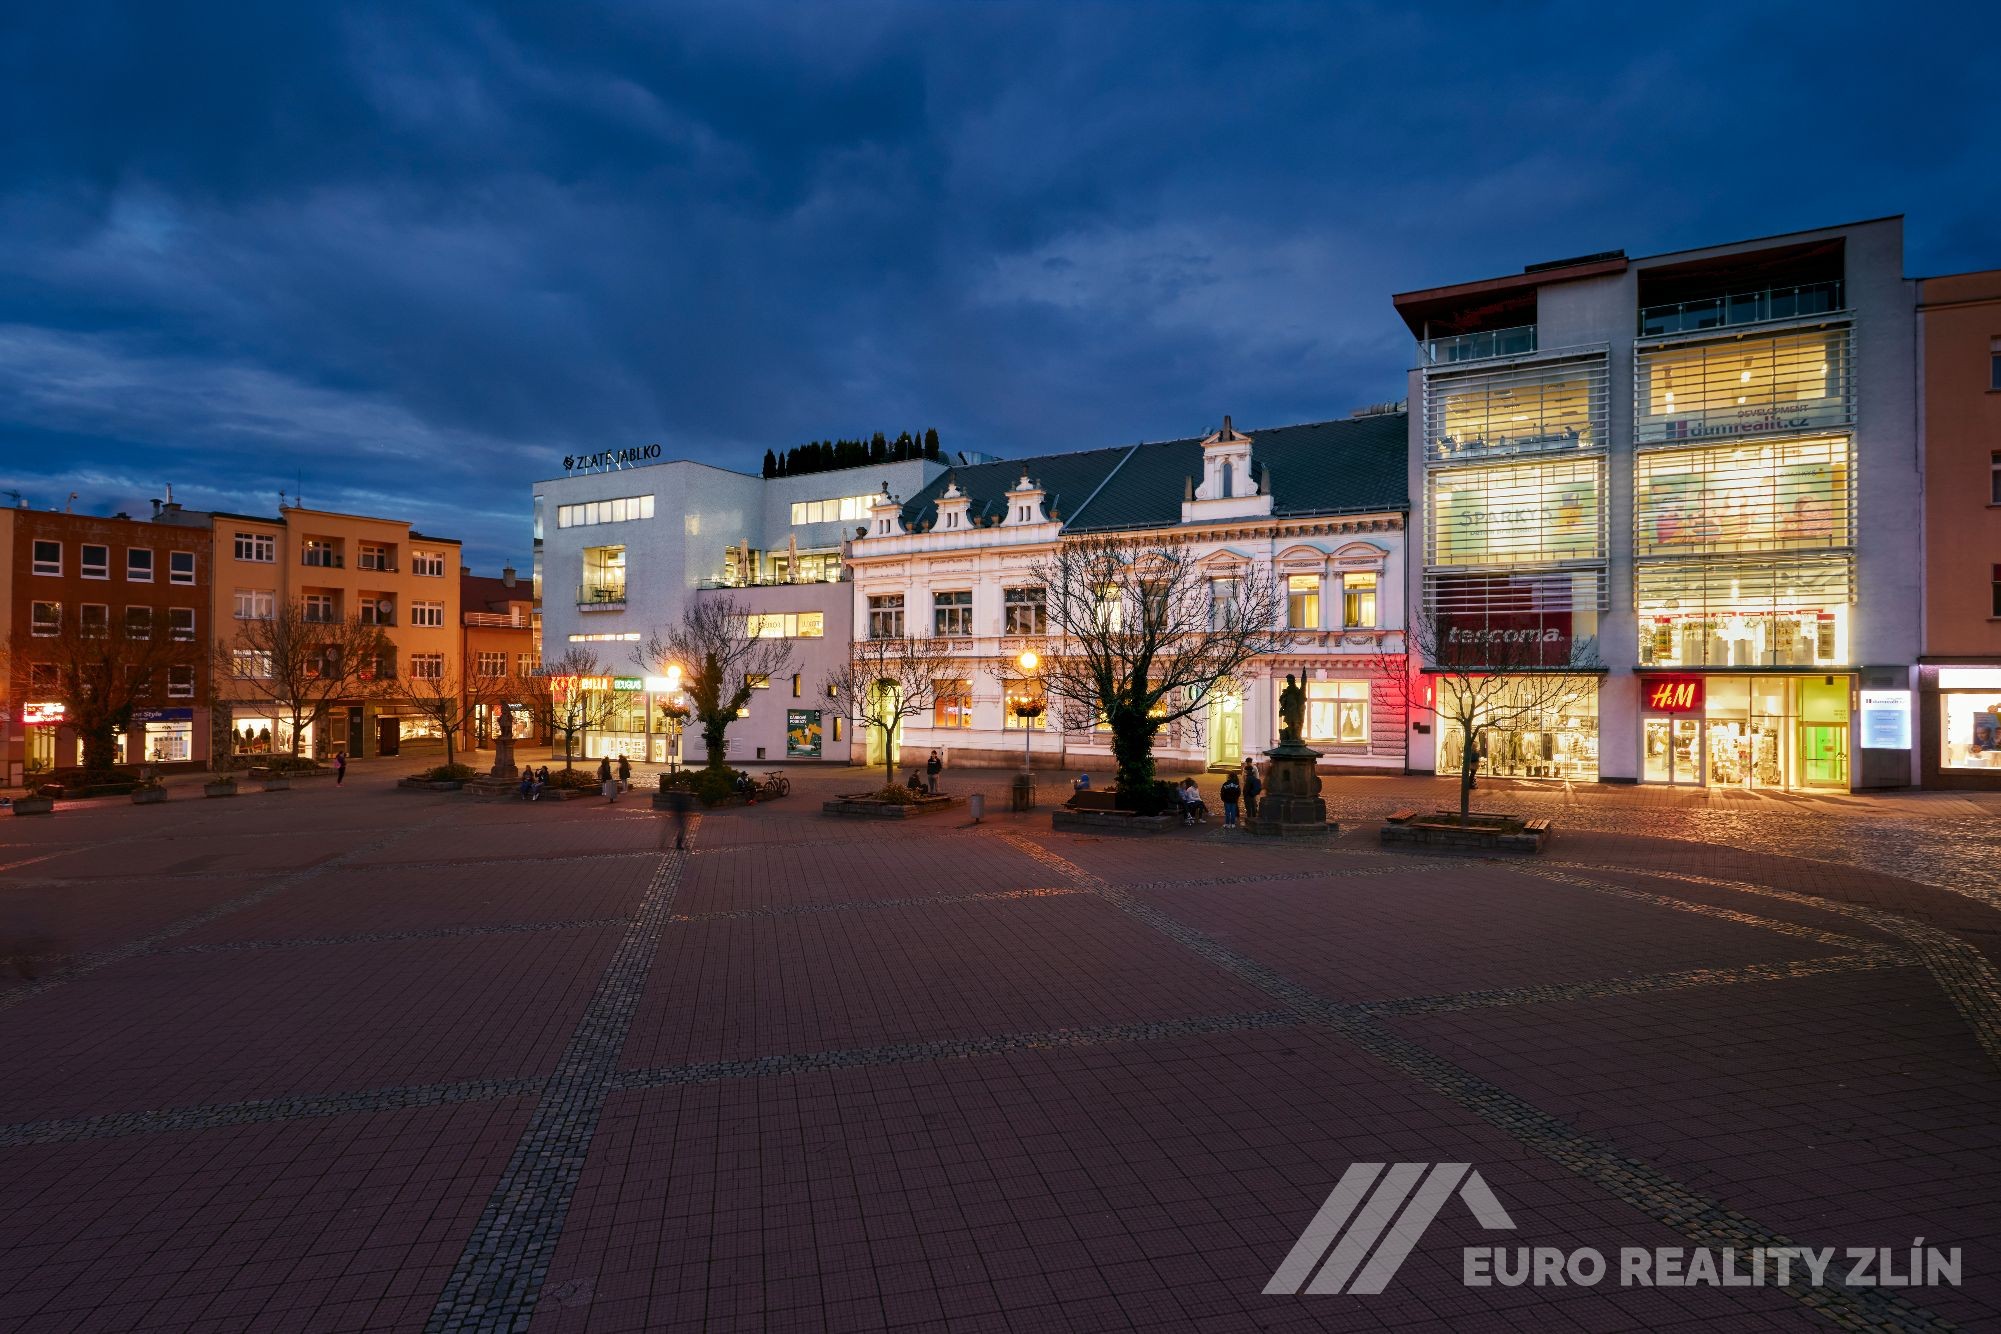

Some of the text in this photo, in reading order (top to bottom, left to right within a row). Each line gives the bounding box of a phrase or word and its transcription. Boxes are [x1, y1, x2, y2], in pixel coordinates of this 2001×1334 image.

[1737, 404, 1809, 418] DEVELOPMENT
[1690, 415, 1810, 437] dumrealit.cz
[576, 444, 661, 470] ZLATÉ JABLKO
[1651, 683, 1696, 708] H&M
